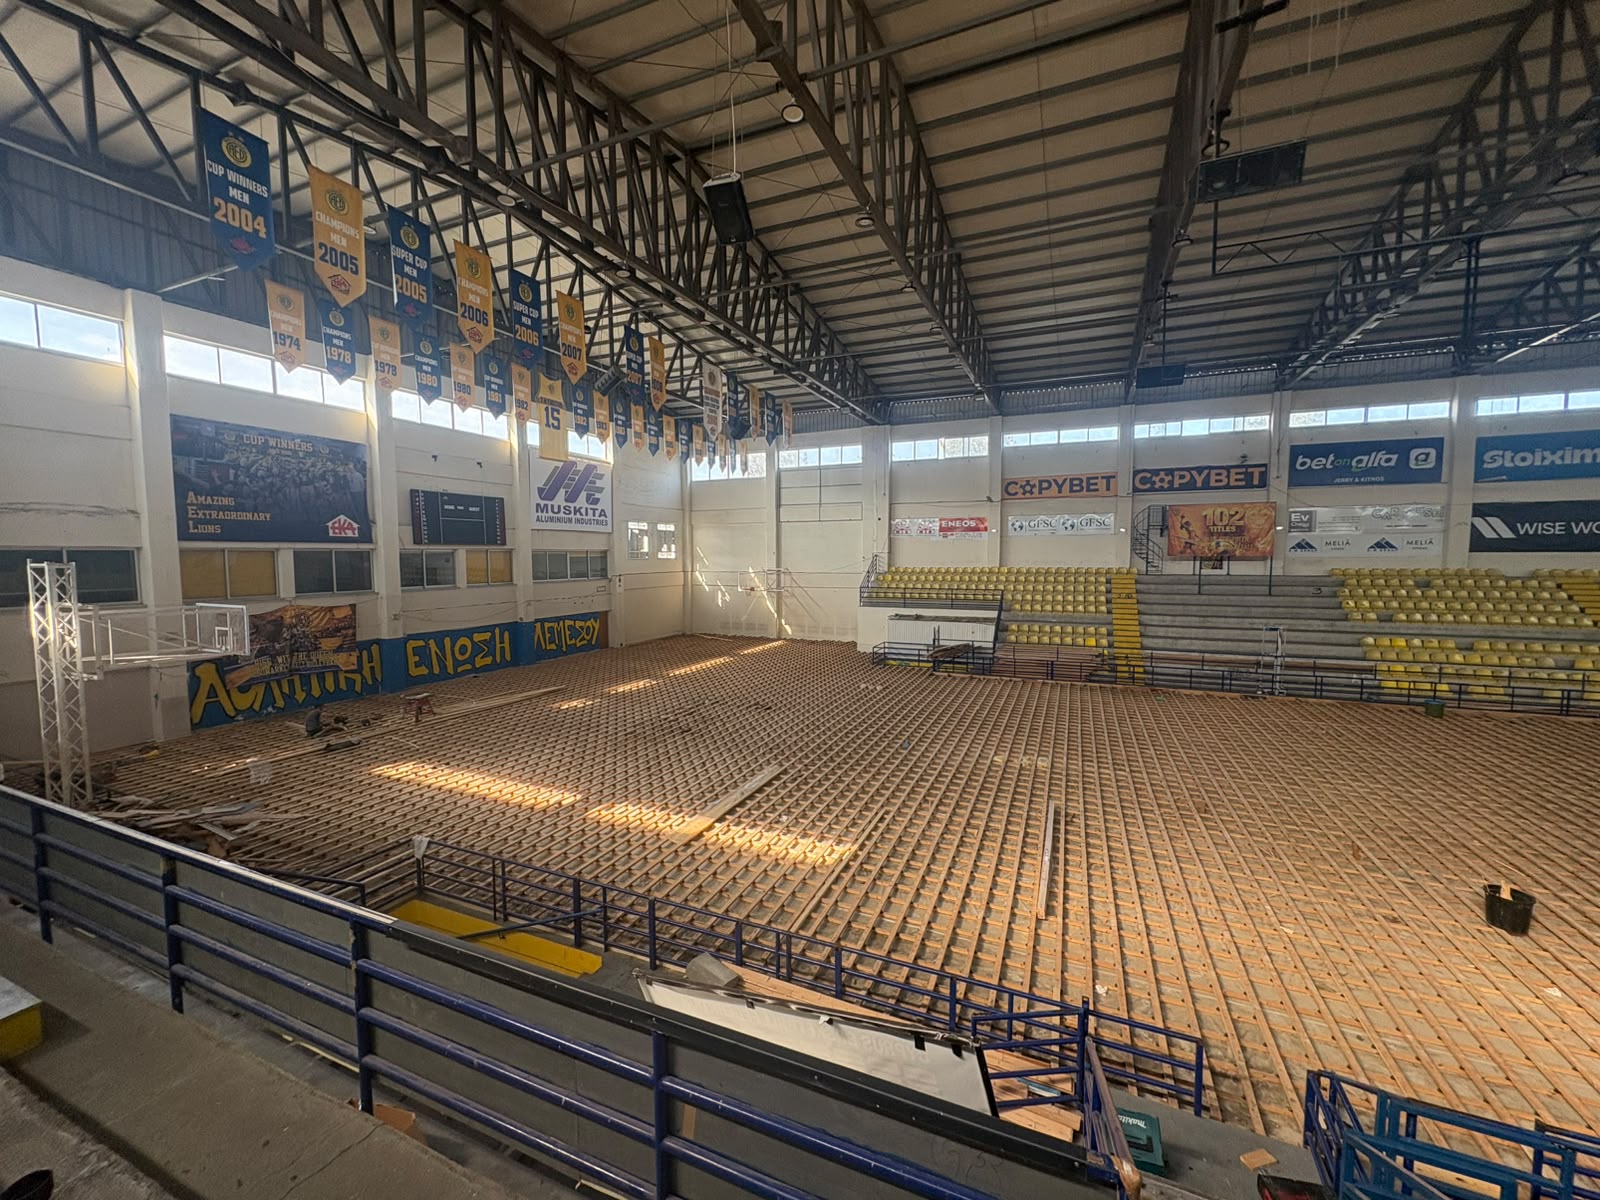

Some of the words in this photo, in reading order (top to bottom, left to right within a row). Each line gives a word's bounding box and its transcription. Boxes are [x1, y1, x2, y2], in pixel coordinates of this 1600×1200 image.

[207, 160, 225, 177] CUP
[226, 168, 269, 198] WINNERS
[229, 185, 250, 206] MEN
[214, 196, 267, 239] 2004
[315, 210, 360, 240] CHAMPIONS
[330, 231, 347, 247] MEN
[319, 241, 359, 275] 2005
[391, 244, 414, 265] SUPER
[414, 255, 428, 270] CUP
[403, 263, 417, 278] MEN
[395, 273, 427, 304] 2005
[460, 302, 489, 327] 2006
[512, 300, 529, 315] SUPER
[529, 307, 539, 319] CUP
[273, 331, 302, 351] 1974
[323, 326, 352, 340] CHAMPIONS
[515, 324, 539, 347] 2006
[326, 345, 352, 365] 1978
[562, 342, 583, 361] 2007
[374, 359, 398, 377] 1978
[417, 371, 438, 388] 1980
[454, 380, 472, 396] 1980
[544, 406, 561, 431] 15
[243, 433, 265, 446] CUP
[266, 436, 314, 452] WINNERS
[1482, 447, 1600, 468] Stoixim
[1003, 475, 1116, 497] COPYBET
[1134, 466, 1266, 490] COPYBET
[535, 502, 609, 519] MUSKITA
[1202, 507, 1246, 526] 102
[535, 514, 573, 525] ALUMINIUM
[574, 517, 609, 527] INDUSTRIES
[942, 519, 977, 528] ENEOS
[1028, 518, 1058, 529] GFSC
[1080, 516, 1111, 528] GFSC
[1209, 525, 1237, 533] TITLES
[1516, 522, 1567, 535] WISE
[533, 617, 601, 653] ΛΕΜΕΣΟΥ
[1117, 1114, 1147, 1129] makita
